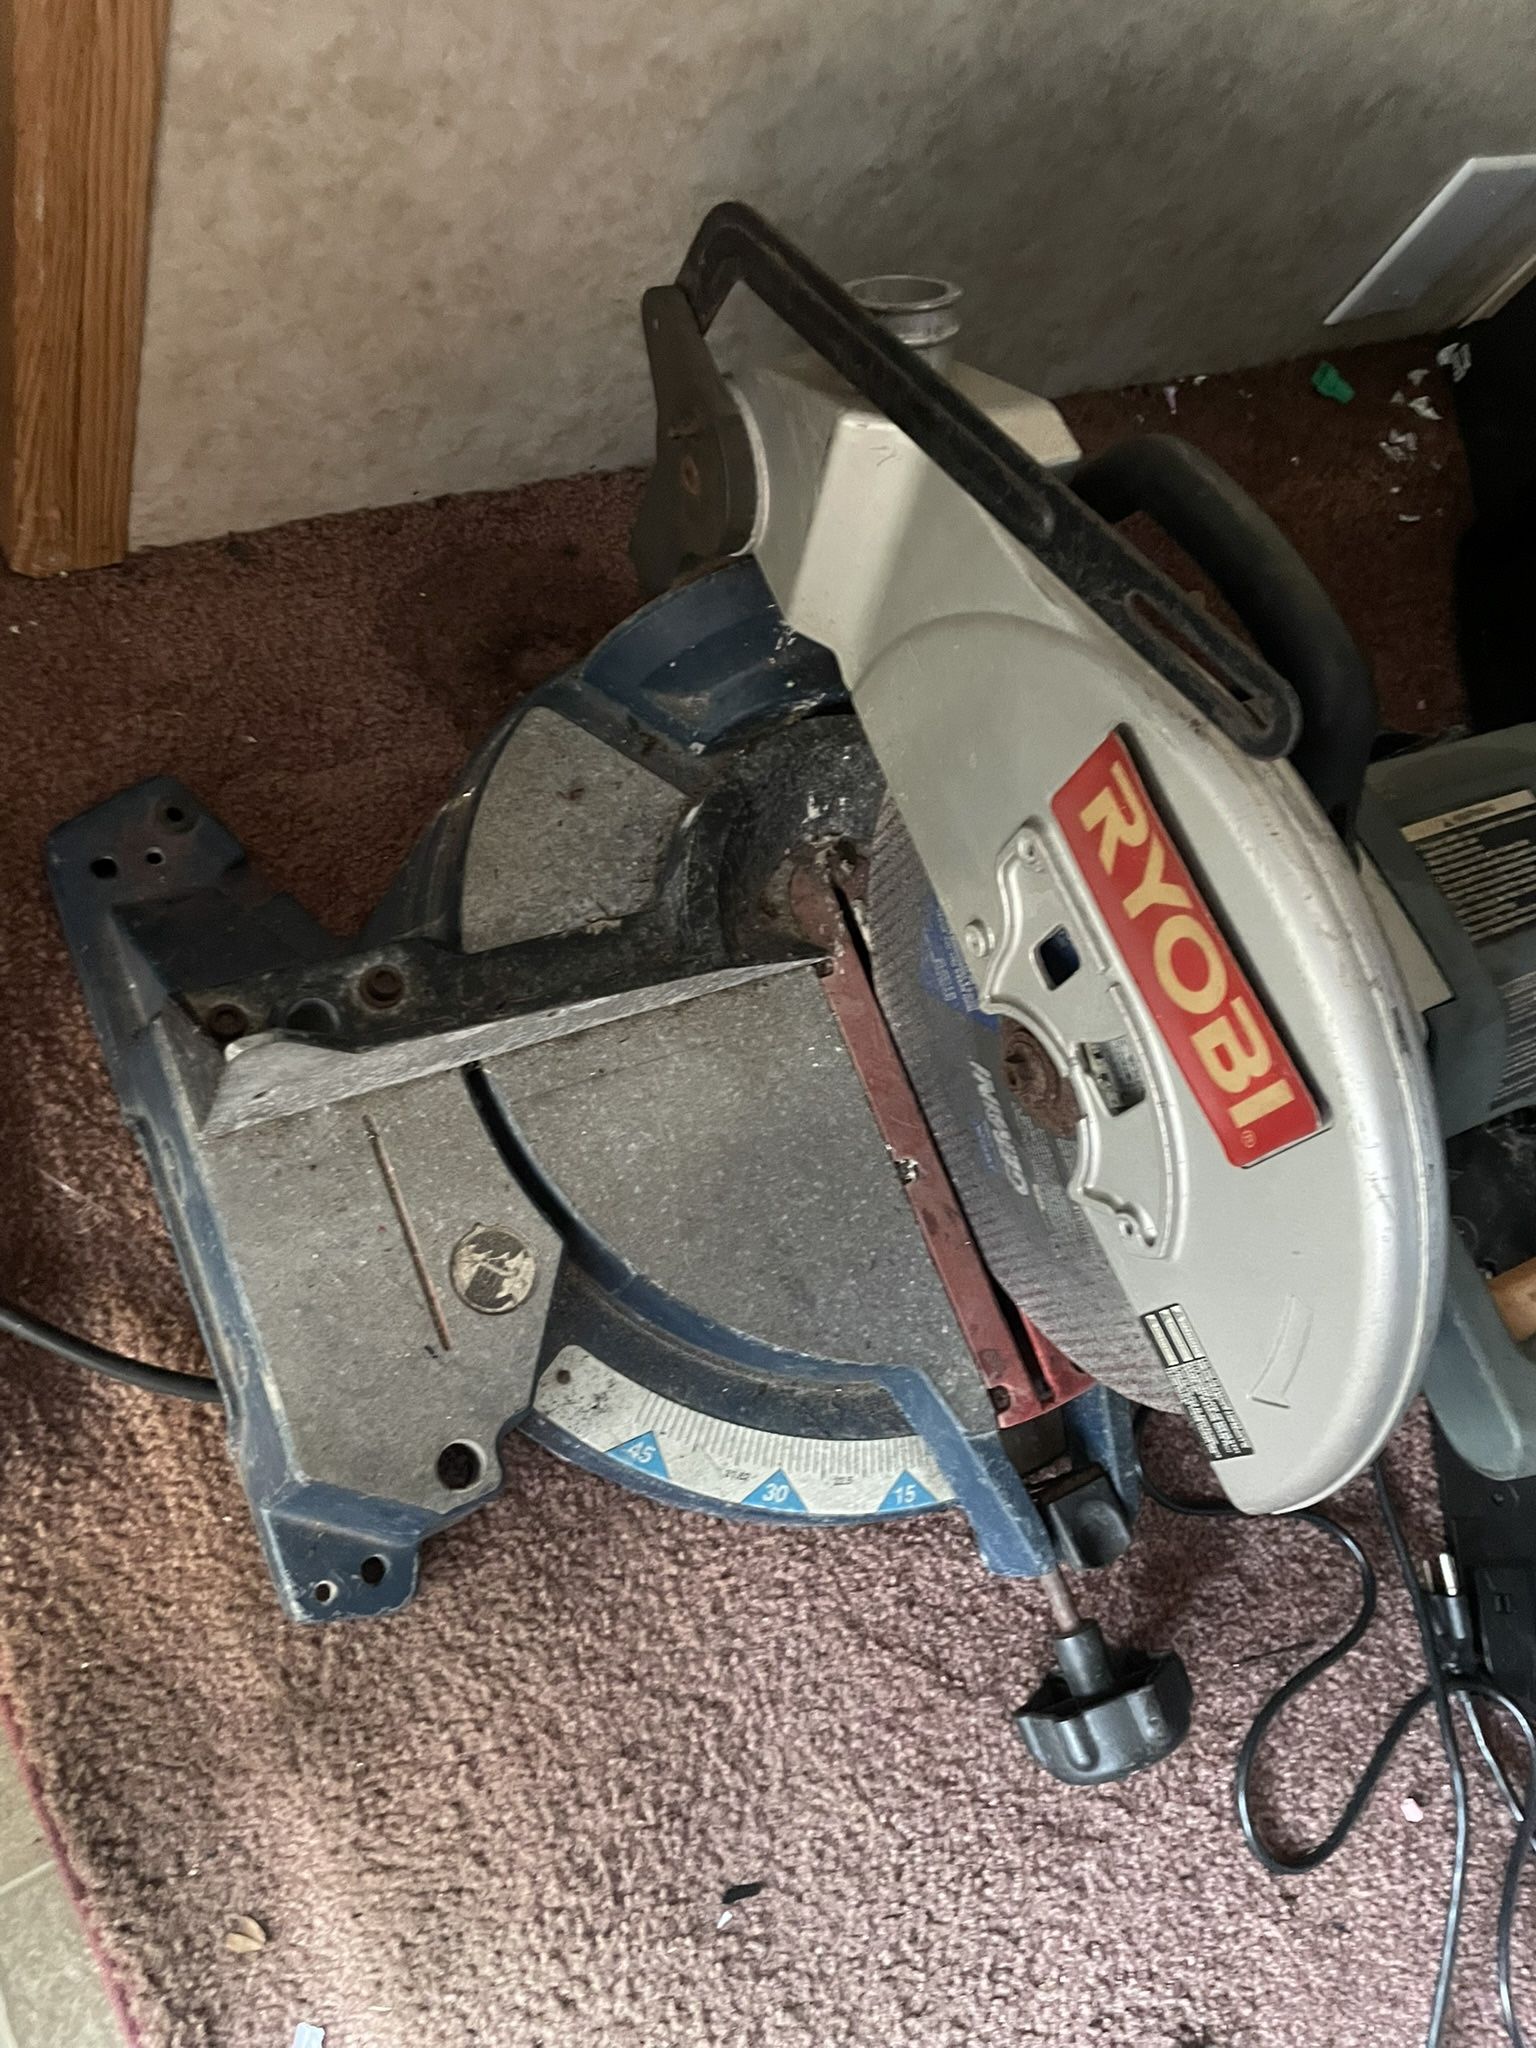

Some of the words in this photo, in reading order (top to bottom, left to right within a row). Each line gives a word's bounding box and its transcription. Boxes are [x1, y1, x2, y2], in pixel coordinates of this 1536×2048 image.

[1079, 760, 1296, 1129] RYOBI
[627, 1441, 657, 1464] 45
[761, 1482, 790, 1504] 30
[894, 1484, 917, 1504] 15
